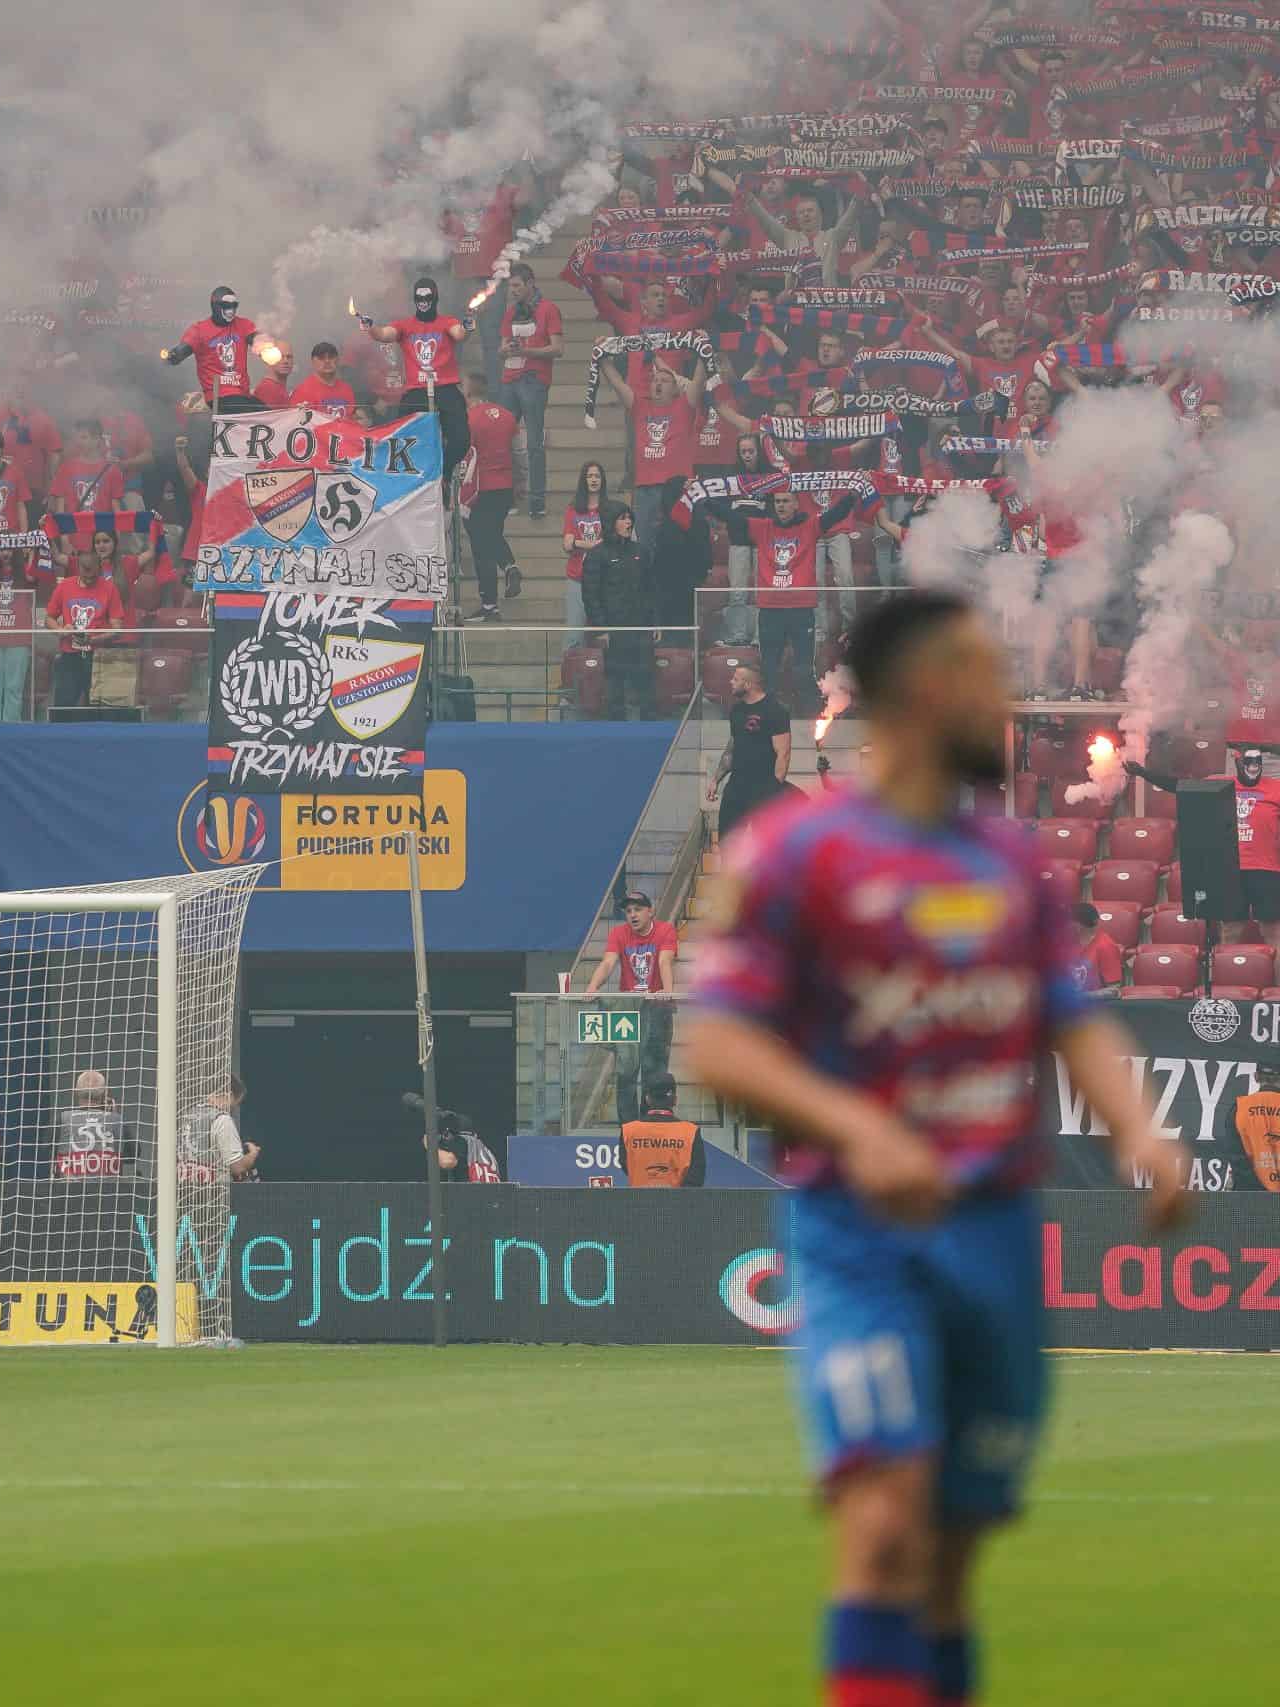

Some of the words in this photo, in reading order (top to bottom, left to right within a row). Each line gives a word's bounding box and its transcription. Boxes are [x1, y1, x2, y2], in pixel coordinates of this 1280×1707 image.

[1015, 189, 1046, 209] THE
[210, 411, 425, 479] KRÓLIK
[251, 476, 278, 489] RKS
[195, 544, 377, 587] RZYMAJ
[331, 644, 369, 660] RKS
[238, 659, 308, 707] ZWD
[353, 715, 378, 728] 1921
[226, 739, 356, 786] TRZYMAJ
[297, 805, 449, 826] FORTUNA
[297, 836, 374, 856] PUCHAR
[381, 836, 450, 856] POSKI
[631, 1138, 685, 1149] STEWARD
[61, 1152, 121, 1176] PHOTO
[135, 1207, 452, 1327] Wejdź
[493, 1236, 616, 1307] na
